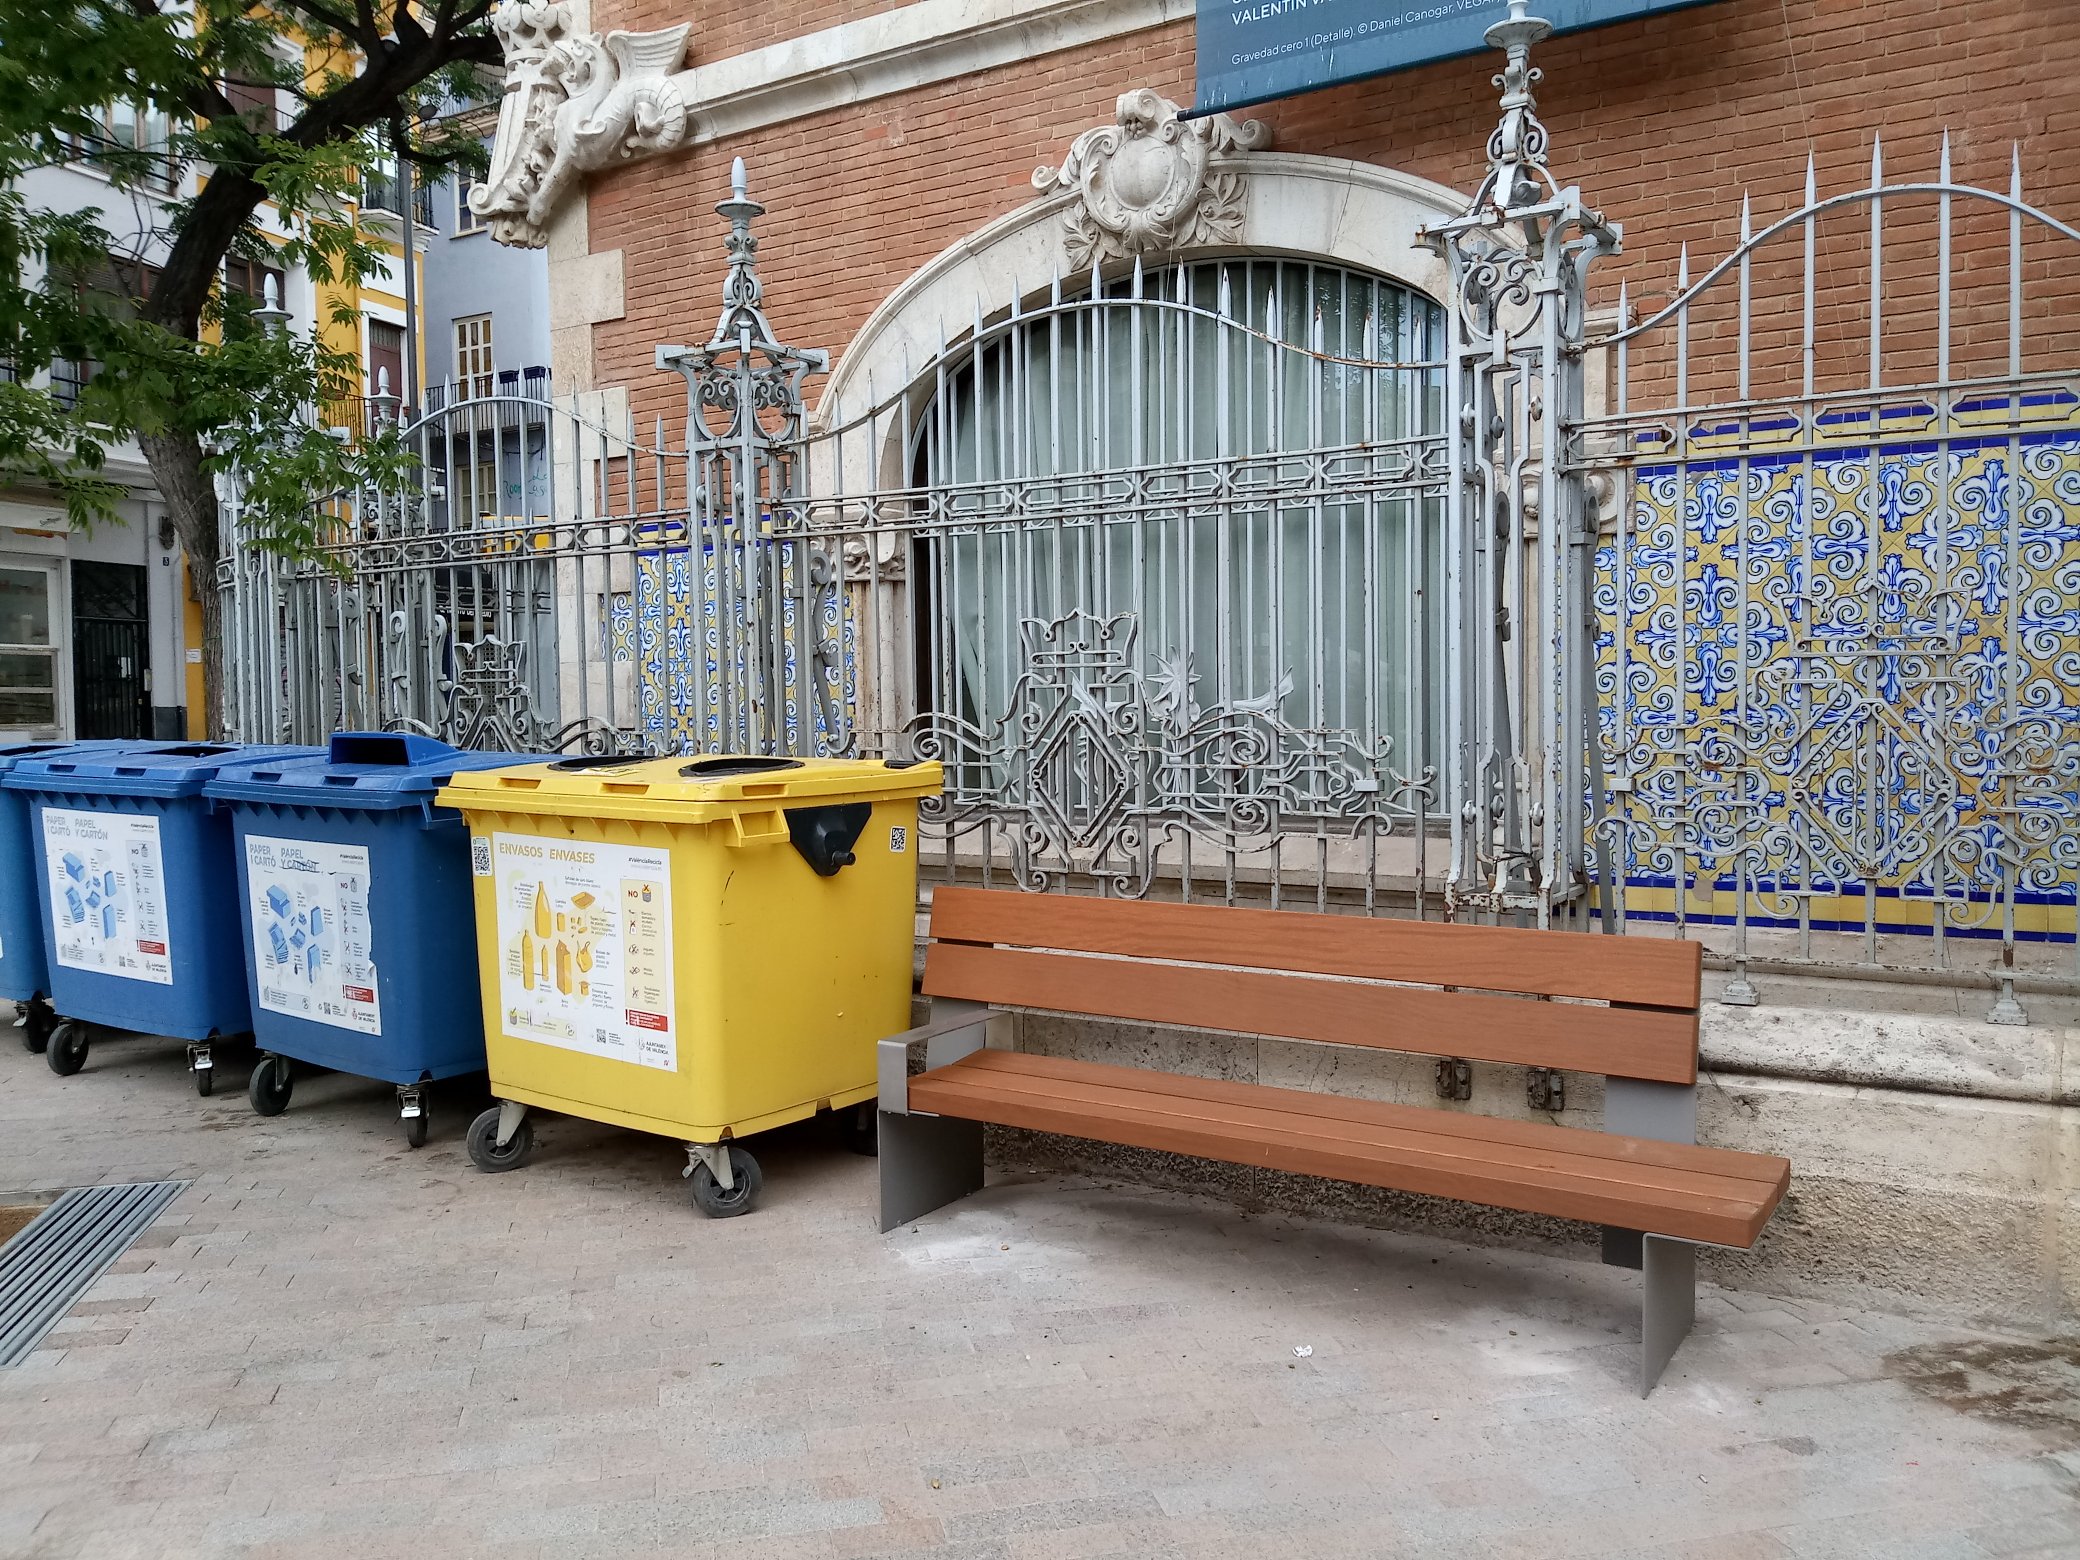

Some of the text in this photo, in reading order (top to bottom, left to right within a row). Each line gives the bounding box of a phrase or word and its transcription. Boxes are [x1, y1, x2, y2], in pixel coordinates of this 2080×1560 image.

[1231, 44, 1279, 65] Gravedad
[1280, 40, 1303, 53] cero
[1304, 37, 1309, 48] 1
[1370, 14, 1403, 32] Daniel
[1405, 4, 1455, 22] Canogar,
[46, 815, 66, 826] PAPER
[75, 817, 97, 829] PAPEL
[80, 828, 108, 841] CARTÓN
[250, 843, 271, 854] PAPER
[281, 847, 304, 859] PAPEL
[499, 842, 595, 864] ENVASOS ENVASES
[254, 854, 277, 868] CARTÓ
[628, 890, 639, 898] NO
